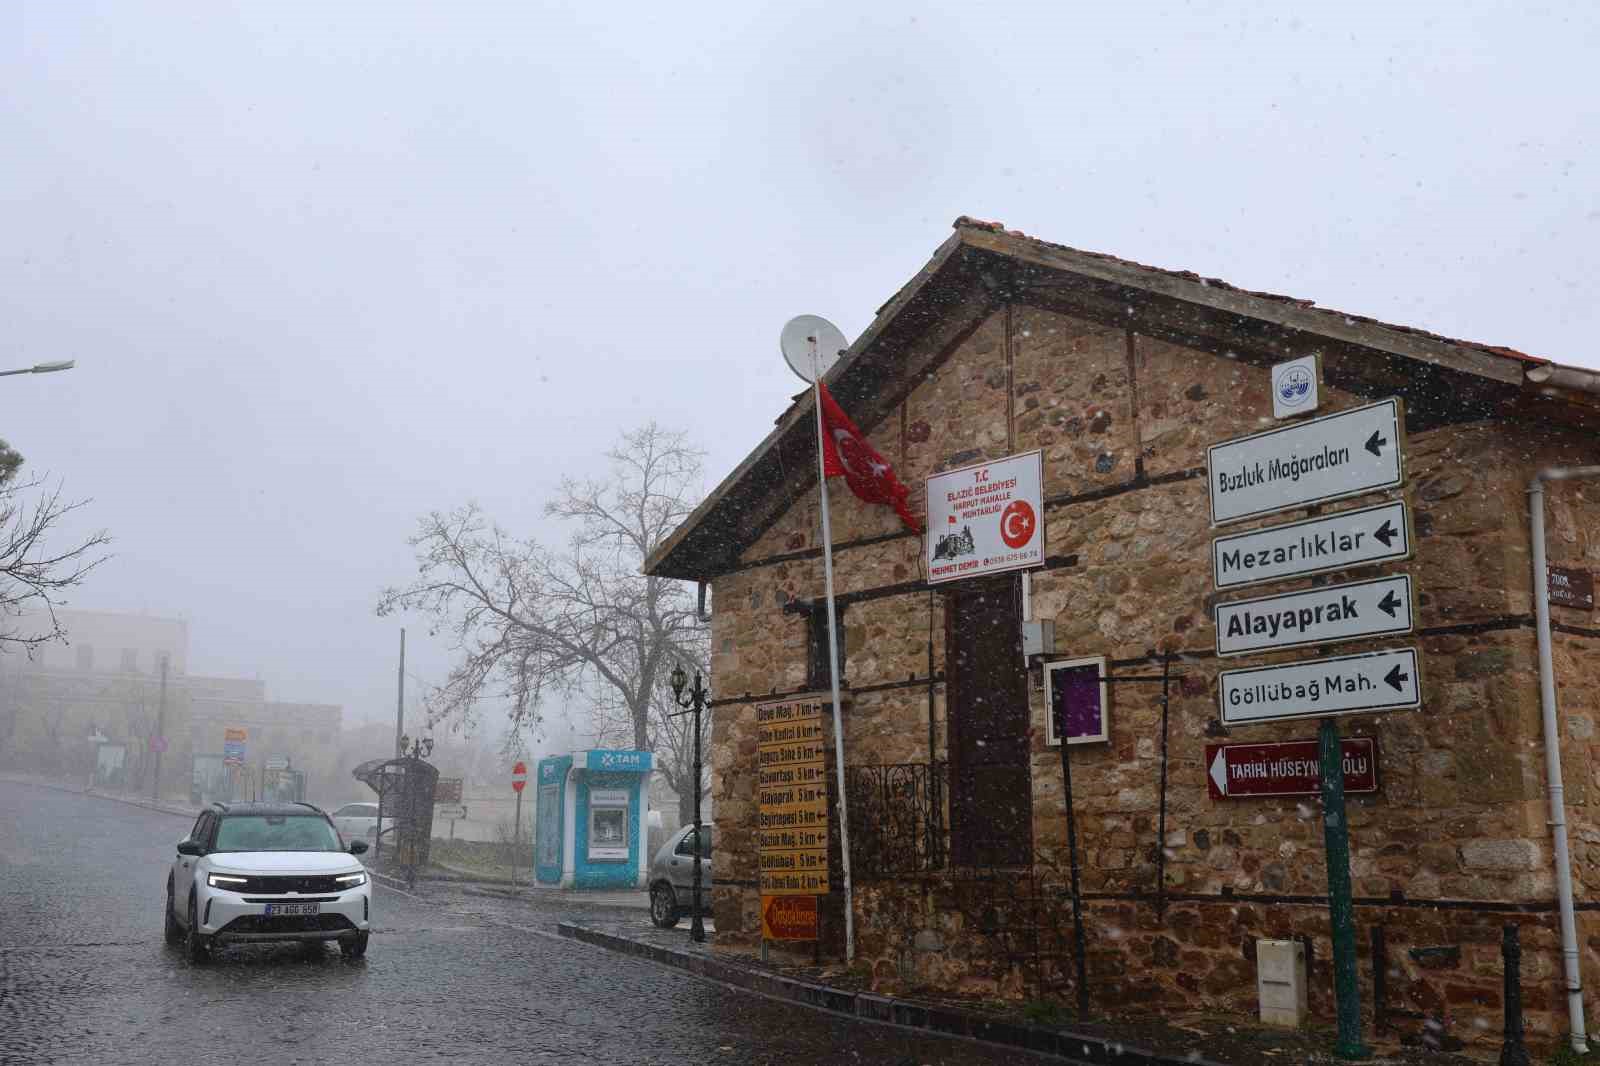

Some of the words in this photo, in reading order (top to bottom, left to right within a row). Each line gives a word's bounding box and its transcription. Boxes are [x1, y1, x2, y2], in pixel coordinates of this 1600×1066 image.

[1219, 462, 1264, 493] Buzluk
[1268, 445, 1350, 482] Mağaraları
[1222, 531, 1365, 572] Mezarlıklar
[1226, 595, 1358, 638] Alayaprak
[1229, 680, 1320, 706] Göllübağ
[1325, 674, 1377, 695] Mah.
[616, 755, 640, 764] TAM
[1271, 759, 1320, 777] HÜSEYN
[1342, 757, 1367, 775] OLU
[804, 789, 815, 801] km
[805, 810, 816, 823] km
[805, 831, 816, 844] km
[806, 853, 817, 866] km
[808, 876, 818, 889] km
